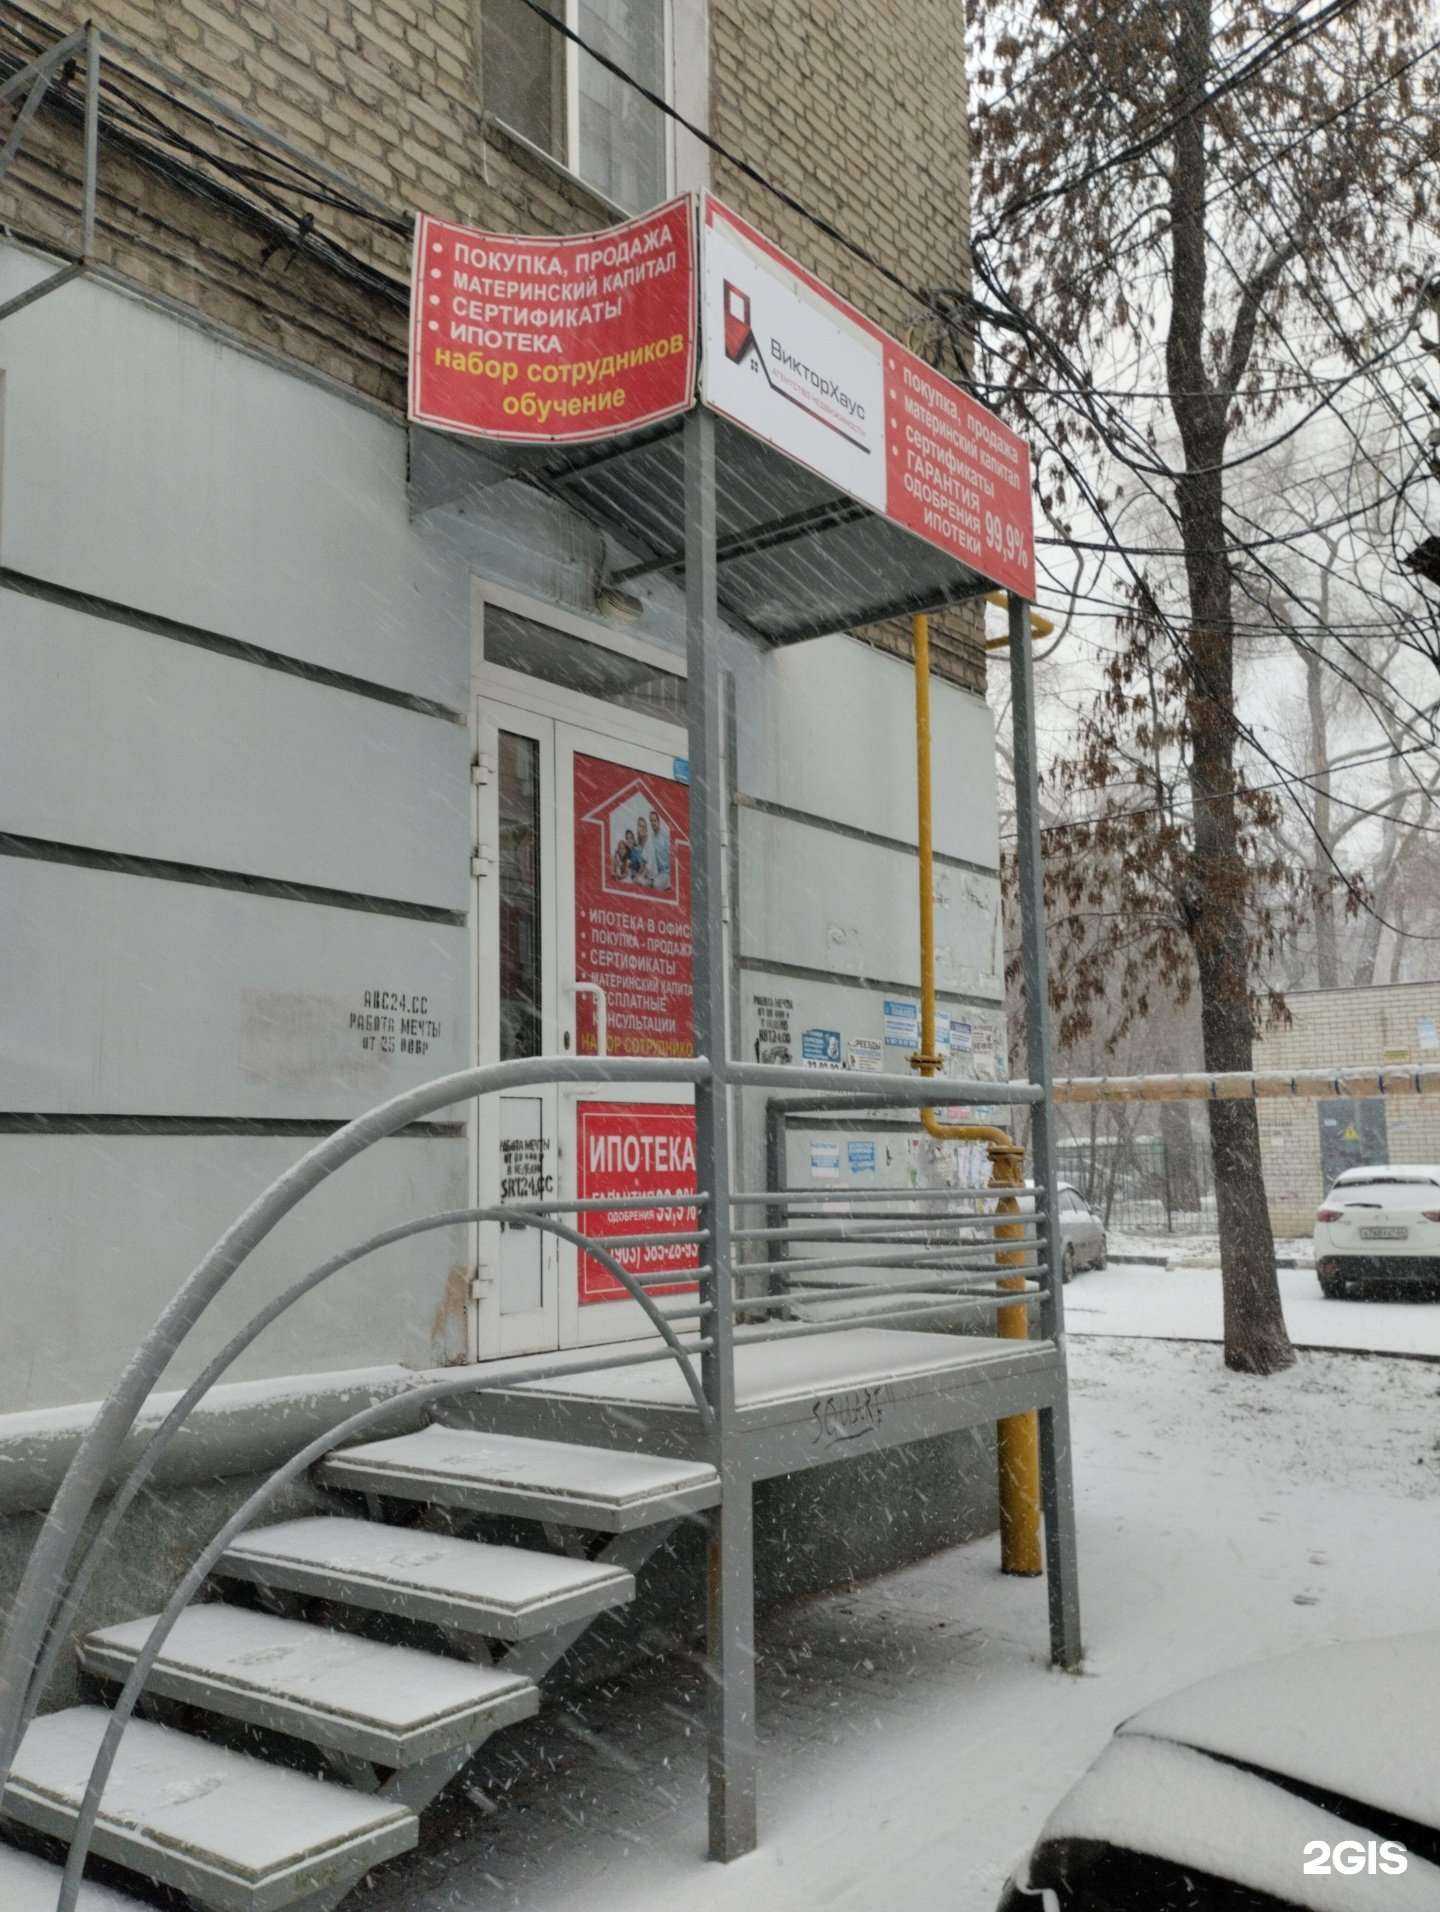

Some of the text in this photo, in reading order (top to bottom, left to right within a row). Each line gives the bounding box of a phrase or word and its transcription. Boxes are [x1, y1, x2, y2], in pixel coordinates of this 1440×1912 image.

[454, 224, 673, 277] ПОКУПКА, ПРОДАЖА
[453, 251, 677, 301] МАТЕРИНСКИЙ КАПИТАЛ
[452, 296, 623, 328] СЕРТИФИКАТЫ
[450, 321, 564, 353] ИПОТЕКА
[434, 334, 684, 386] набор сотрудников
[770, 338, 866, 420] ВикторХаус
[503, 388, 626, 423] обучение
[904, 395, 978, 460] материнский
[980, 449, 1021, 491] капитал
[967, 414, 1019, 464] продажа
[905, 425, 995, 498] сертификаты
[906, 450, 980, 514] ГАРАНТИЯ
[904, 473, 981, 535] ОДОБРЕНИЯ
[924, 508, 1029, 569] ИПОТЕКИ 99,9%
[589, 909, 693, 938] ИПОТЕКА В ОФИС
[591, 929, 640, 950] ПОКУПКА
[647, 938, 694, 957] ПРОДАЖ
[590, 950, 676, 975] СЕРТИФИКАТЫ
[592, 991, 667, 1012] БСПЛАТНЫЕ
[661, 981, 693, 997] КАПИТА
[581, 1032, 694, 1057] НАОР СОТРУДНИКО
[590, 1135, 697, 1173] ИПОТЕКА
